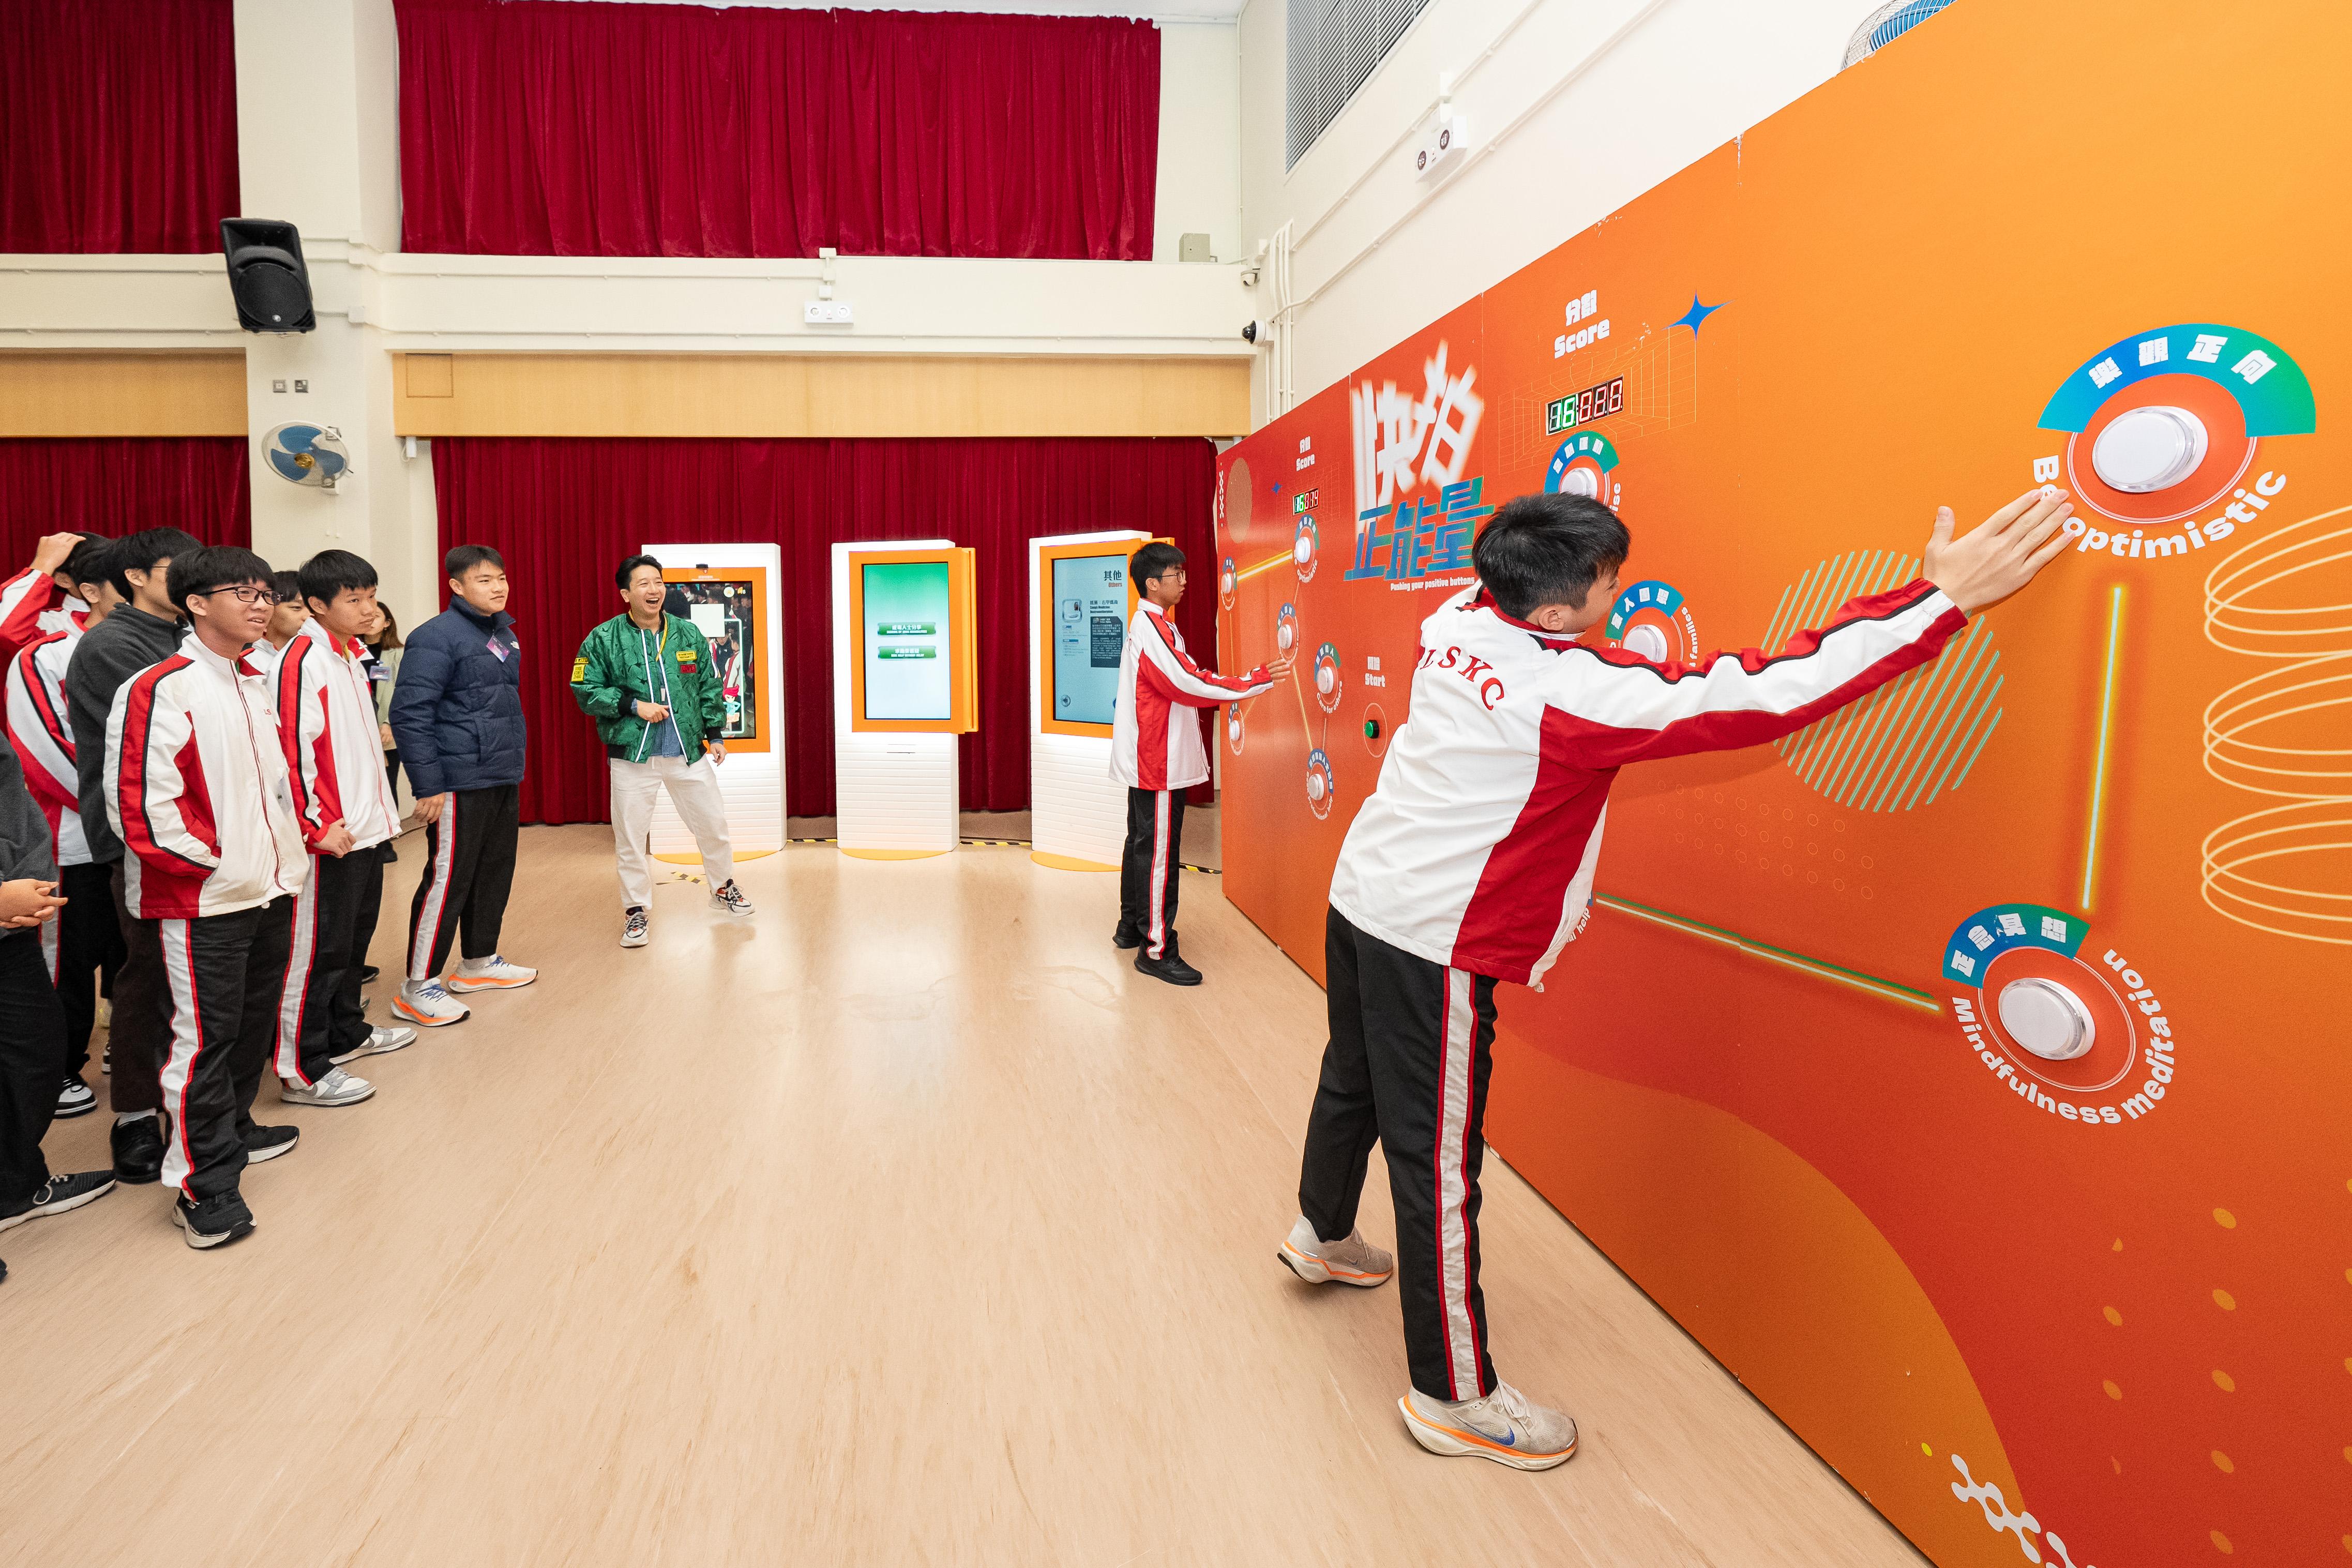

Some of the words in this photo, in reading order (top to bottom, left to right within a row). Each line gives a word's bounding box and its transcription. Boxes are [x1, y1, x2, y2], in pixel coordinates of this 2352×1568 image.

[1554, 319, 1610, 359] Score
[2088, 334, 2277, 389] 樂觀正向
[1296, 454, 1315, 471] Score
[1343, 475, 1496, 580] 正能量
[2062, 471, 2287, 559] optimistic
[1104, 570, 1122, 581] 其他
[1296, 559, 1318, 583] optimistic
[1391, 582, 1410, 591] Pushing
[1411, 582, 1424, 591] your
[1425, 578, 1449, 590] positive
[1450, 577, 1475, 586] buttons
[1681, 607, 1698, 660] families
[1365, 673, 1385, 687] Start
[1952, 996, 2122, 1124] Mindfulness
[2103, 948, 2175, 1120] meditation
